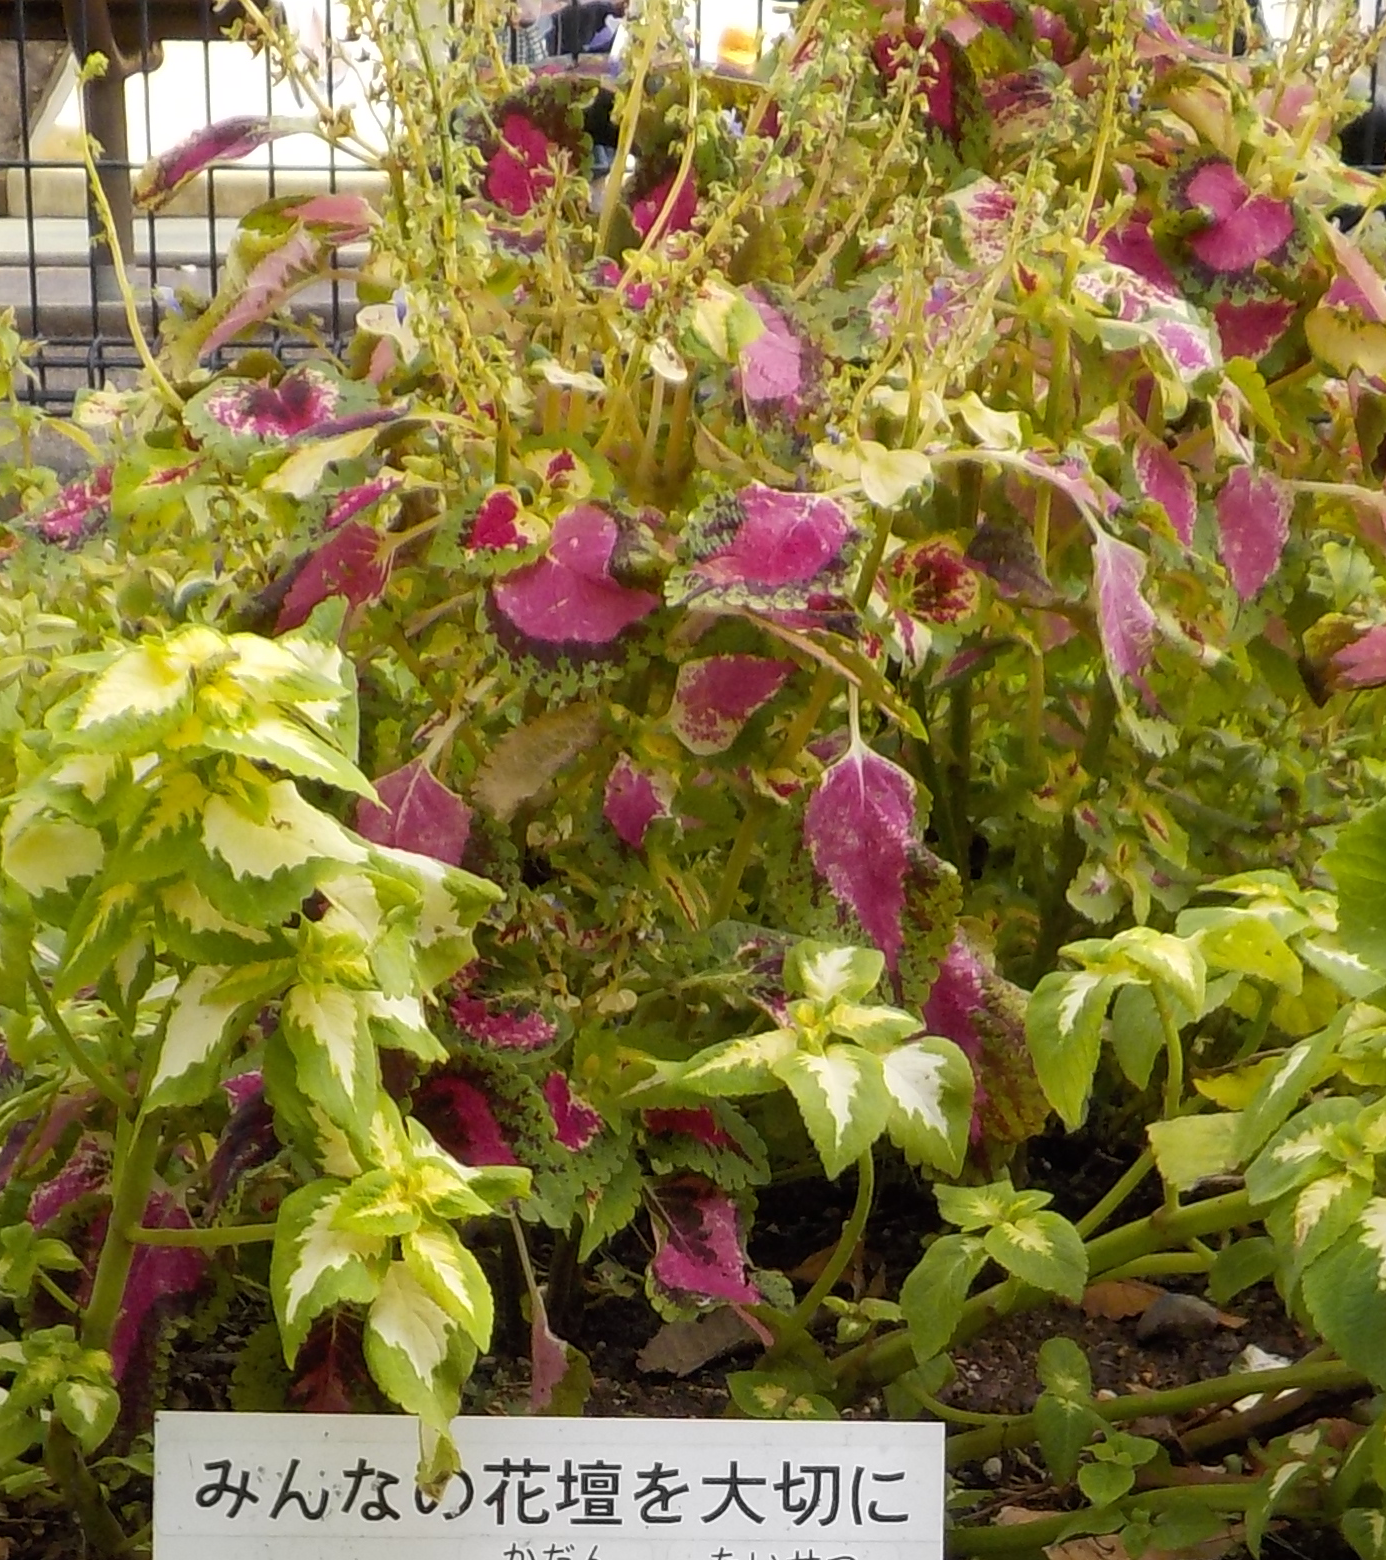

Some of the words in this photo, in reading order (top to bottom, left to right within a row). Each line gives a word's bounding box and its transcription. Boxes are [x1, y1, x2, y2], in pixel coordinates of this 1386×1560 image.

[195, 1457, 910, 1527] みんなの花壇を大切に
